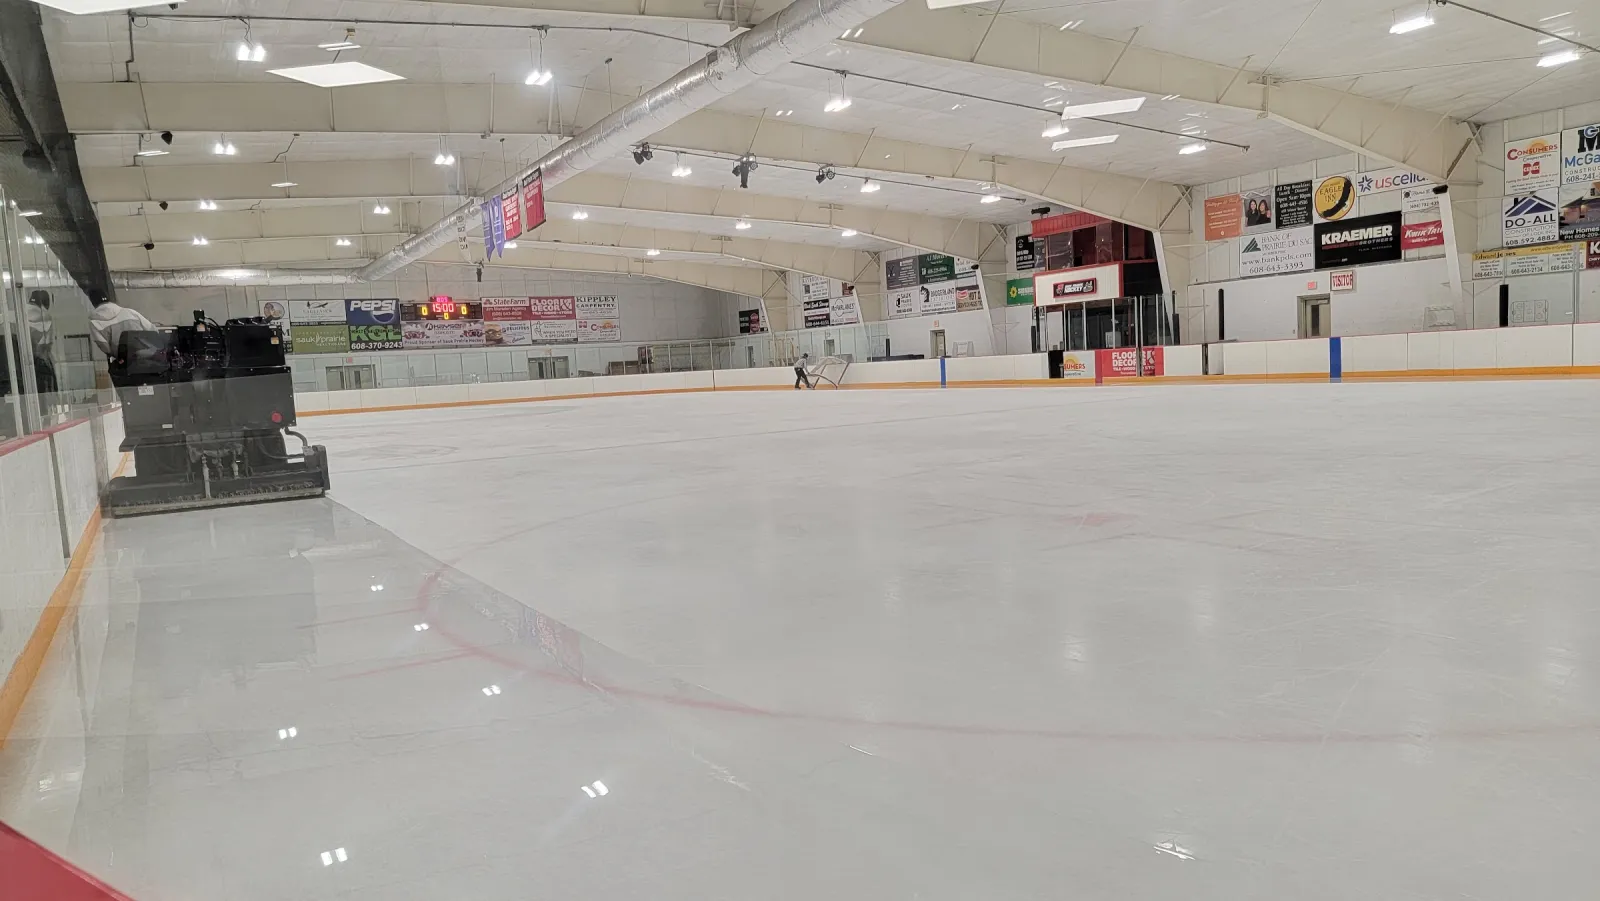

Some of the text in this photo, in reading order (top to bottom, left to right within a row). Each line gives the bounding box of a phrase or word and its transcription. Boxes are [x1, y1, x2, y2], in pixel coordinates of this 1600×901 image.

[1507, 143, 1558, 160] CONSUMERS
[1320, 185, 1342, 195] EAGLE
[1325, 193, 1336, 202] INN
[1505, 213, 1556, 229] DO-ALL
[1321, 224, 1393, 246] KRAEMER
[1505, 224, 1556, 236] CONSTRUCTION
[1576, 226, 1600, 234] Homes
[1261, 233, 1292, 244] BANK OF
[1359, 236, 1393, 246] BROTHERS
[1261, 241, 1288, 251] PRAIRIE
[1288, 239, 1299, 247] DU
[1299, 237, 1313, 246] SAC
[1242, 252, 1312, 266] www.bankpds.com
[1474, 252, 1497, 260] Edward
[1249, 261, 1304, 274] 608-643-3393
[1332, 273, 1354, 287] VISITOR
[349, 299, 396, 312] PEPSI
[531, 298, 559, 306] FLOOR
[421, 306, 428, 316] 0
[432, 303, 455, 313] 15:00
[461, 305, 467, 315] 0
[531, 304, 560, 312] DECOR
[443, 312, 449, 320] 0
[350, 325, 402, 341] KGL
[295, 335, 346, 344] sauk prairie
[351, 341, 403, 350] 608-370-9243
